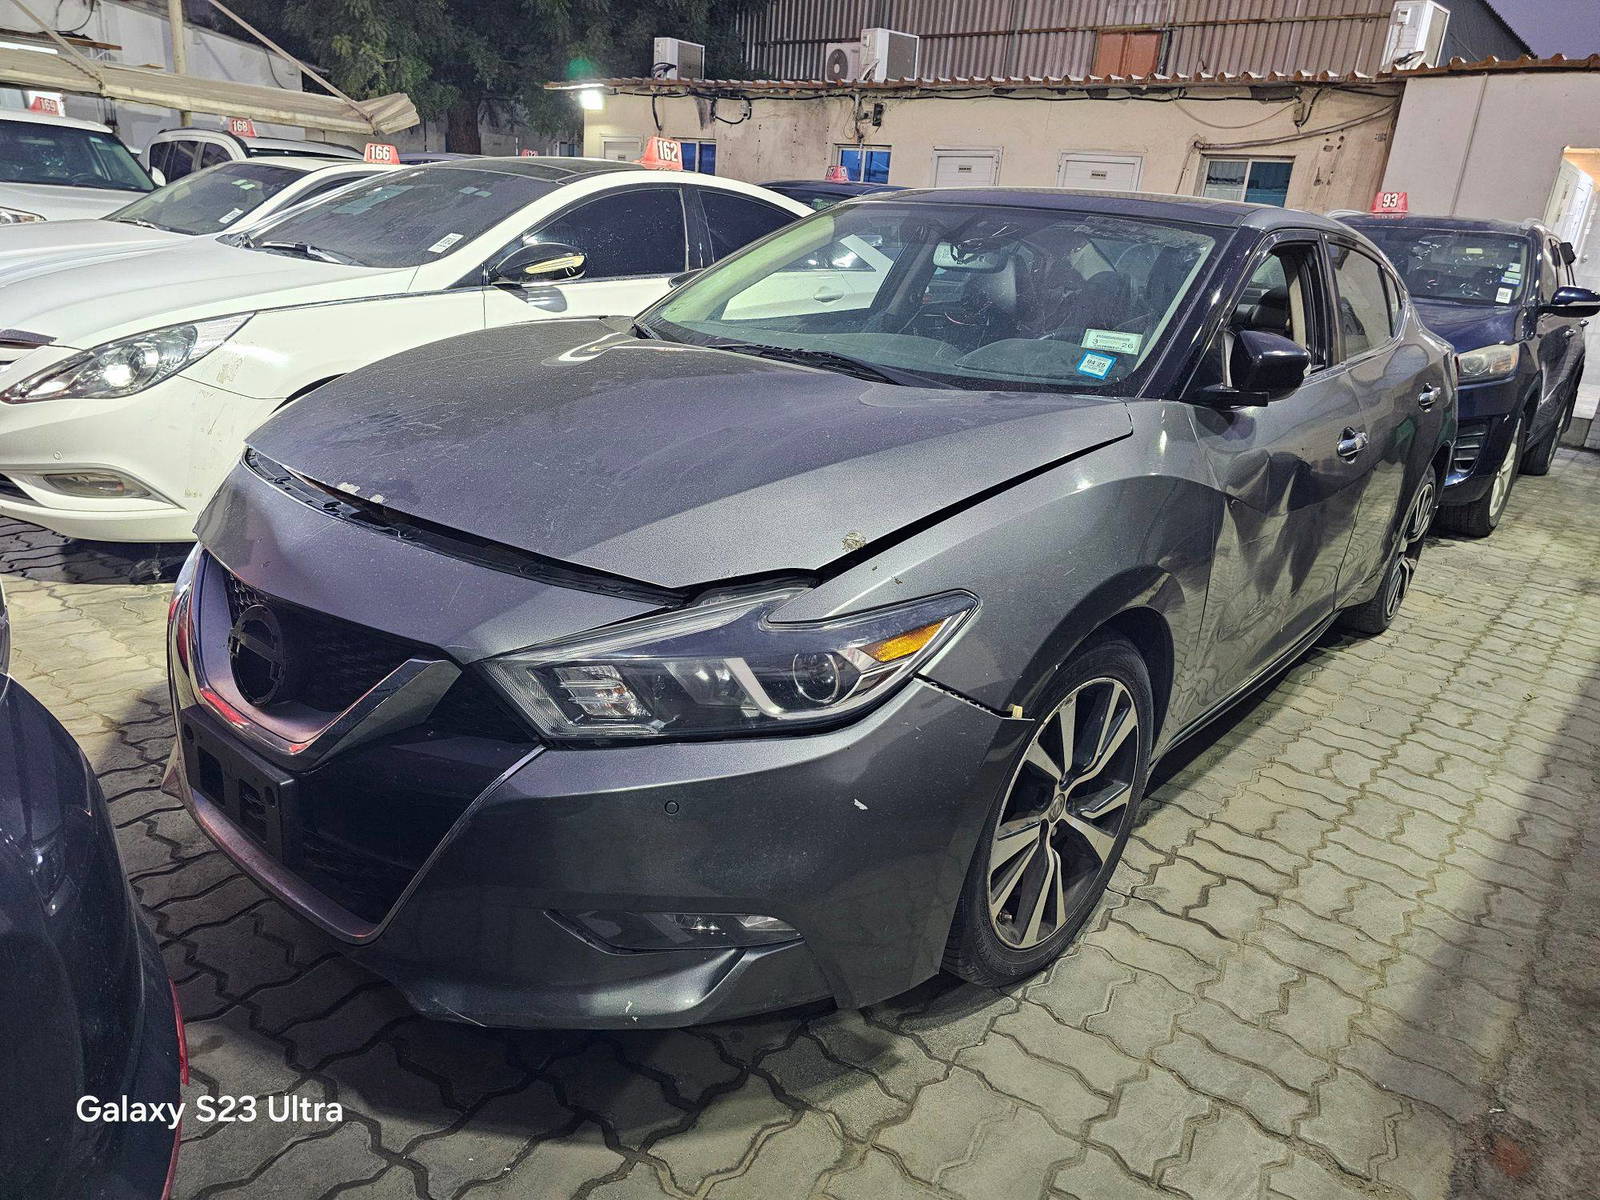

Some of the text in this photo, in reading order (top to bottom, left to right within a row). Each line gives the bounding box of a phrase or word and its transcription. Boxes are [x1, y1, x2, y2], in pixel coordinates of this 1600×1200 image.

[232, 119, 248, 132] 168
[369, 144, 390, 161] 166
[657, 140, 679, 162] 162
[1382, 192, 1399, 208] 93
